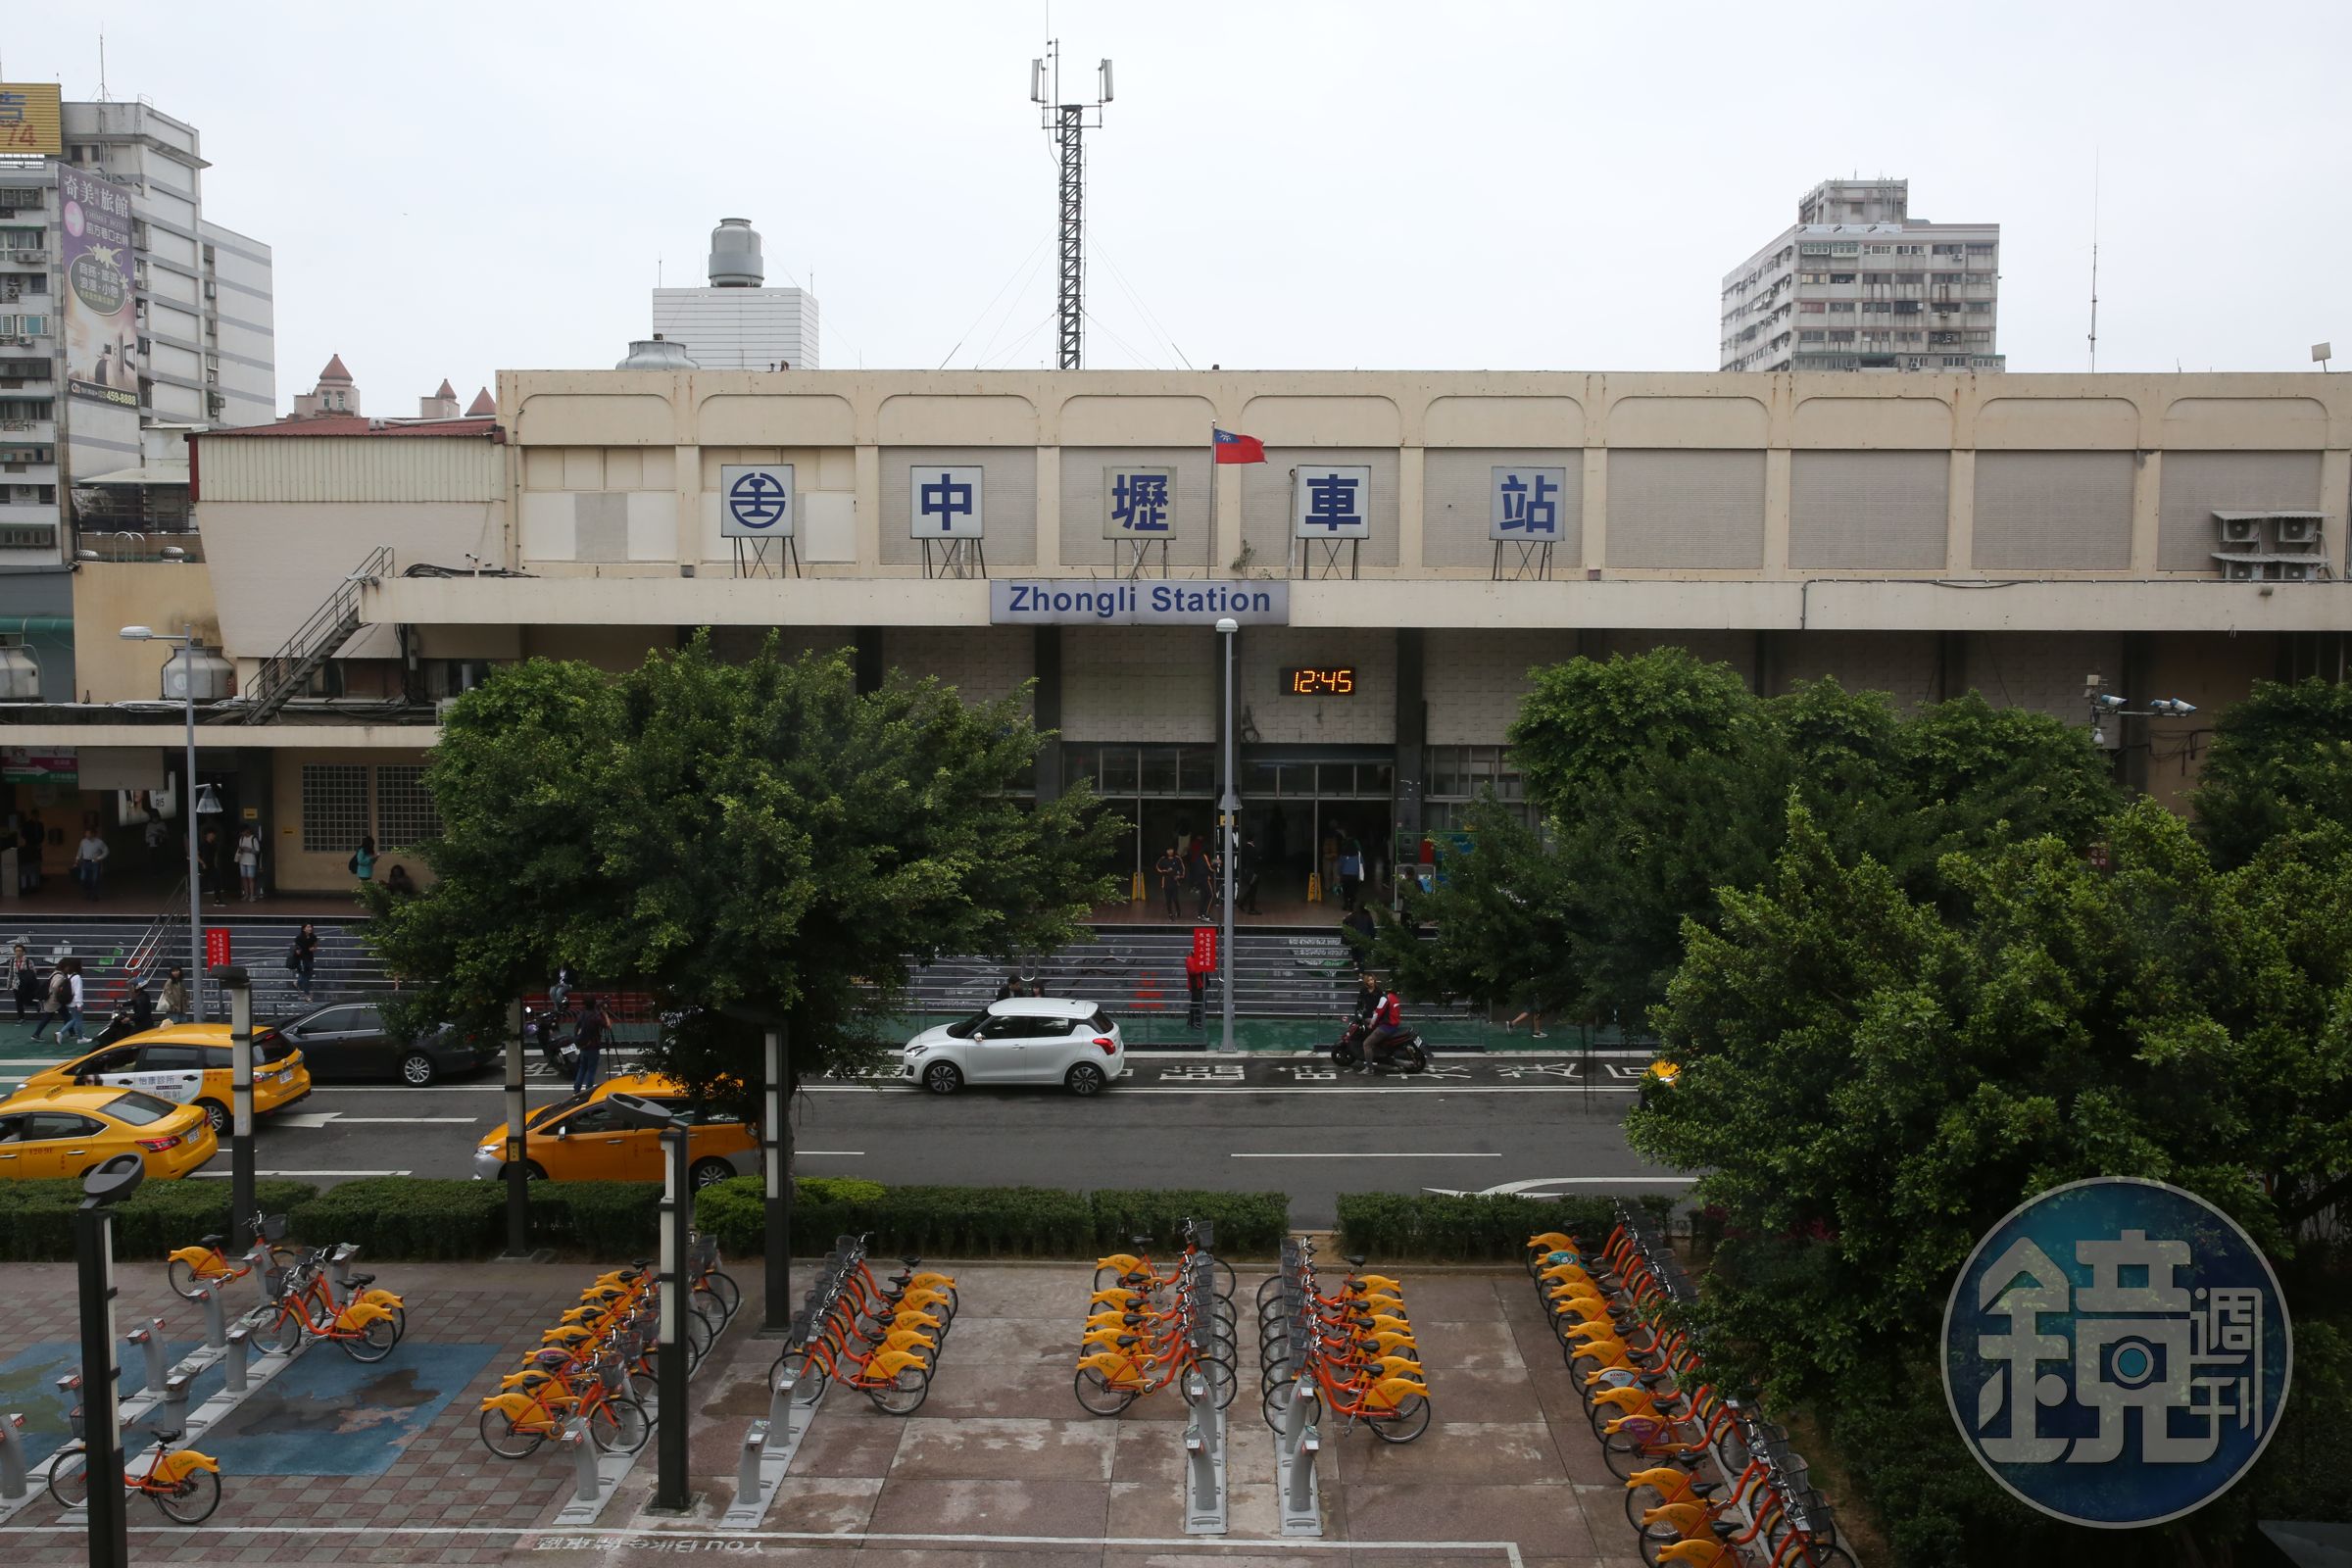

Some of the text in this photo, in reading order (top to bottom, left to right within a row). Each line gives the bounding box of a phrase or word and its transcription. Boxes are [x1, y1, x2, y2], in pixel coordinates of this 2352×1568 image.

[100, 187, 128, 219] 旅館
[920, 473, 1557, 533] 中 壢 車 站
[1009, 586, 1270, 617] Zhongli Station
[1294, 670, 1351, 693] 12:45
